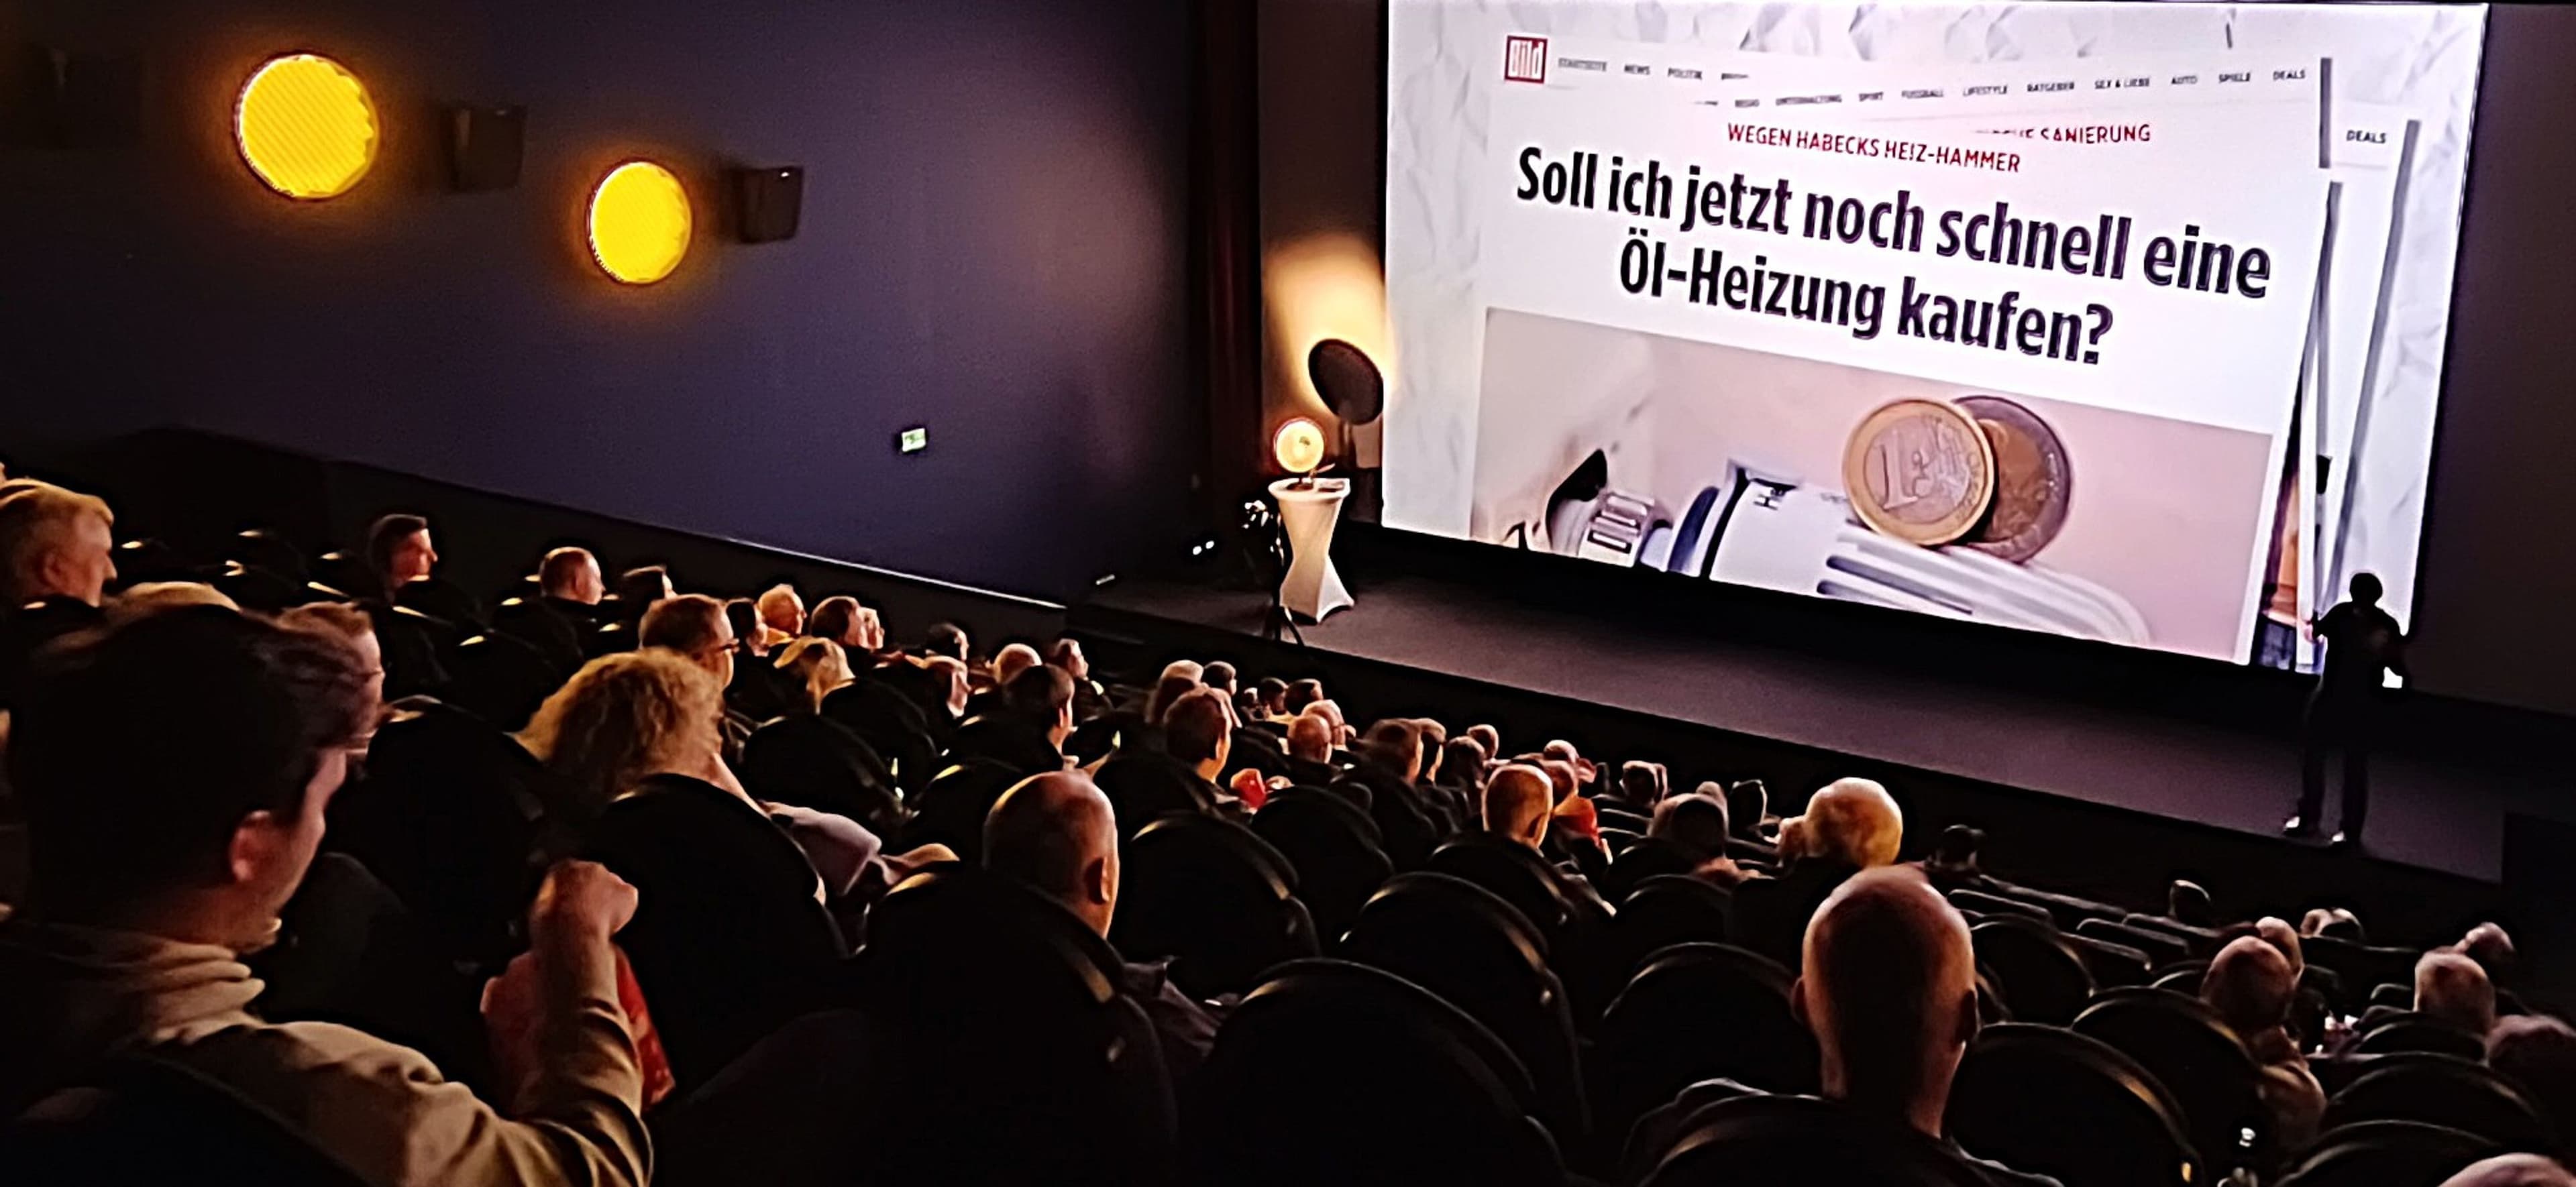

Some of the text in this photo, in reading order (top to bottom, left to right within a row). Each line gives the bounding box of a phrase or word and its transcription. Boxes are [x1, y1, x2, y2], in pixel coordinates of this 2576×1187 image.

[1623, 64, 1650, 75] NEWS
[1963, 85, 2008, 96] LIFESTYLE
[2171, 75, 2198, 84] AUTO
[2218, 72, 2251, 83] SPIELE
[2273, 69, 2306, 81] DEALS
[2040, 123, 2151, 145] SANIERUNG
[2347, 129, 2387, 144] DEALS
[1728, 123, 2021, 173] WEGEN HABECKS HEIZ-HAMMER
[1517, 147, 2270, 298] Soll ich jetzt noch schnell eine
[1621, 227, 2112, 365] Öl-Heizung kaufen?
